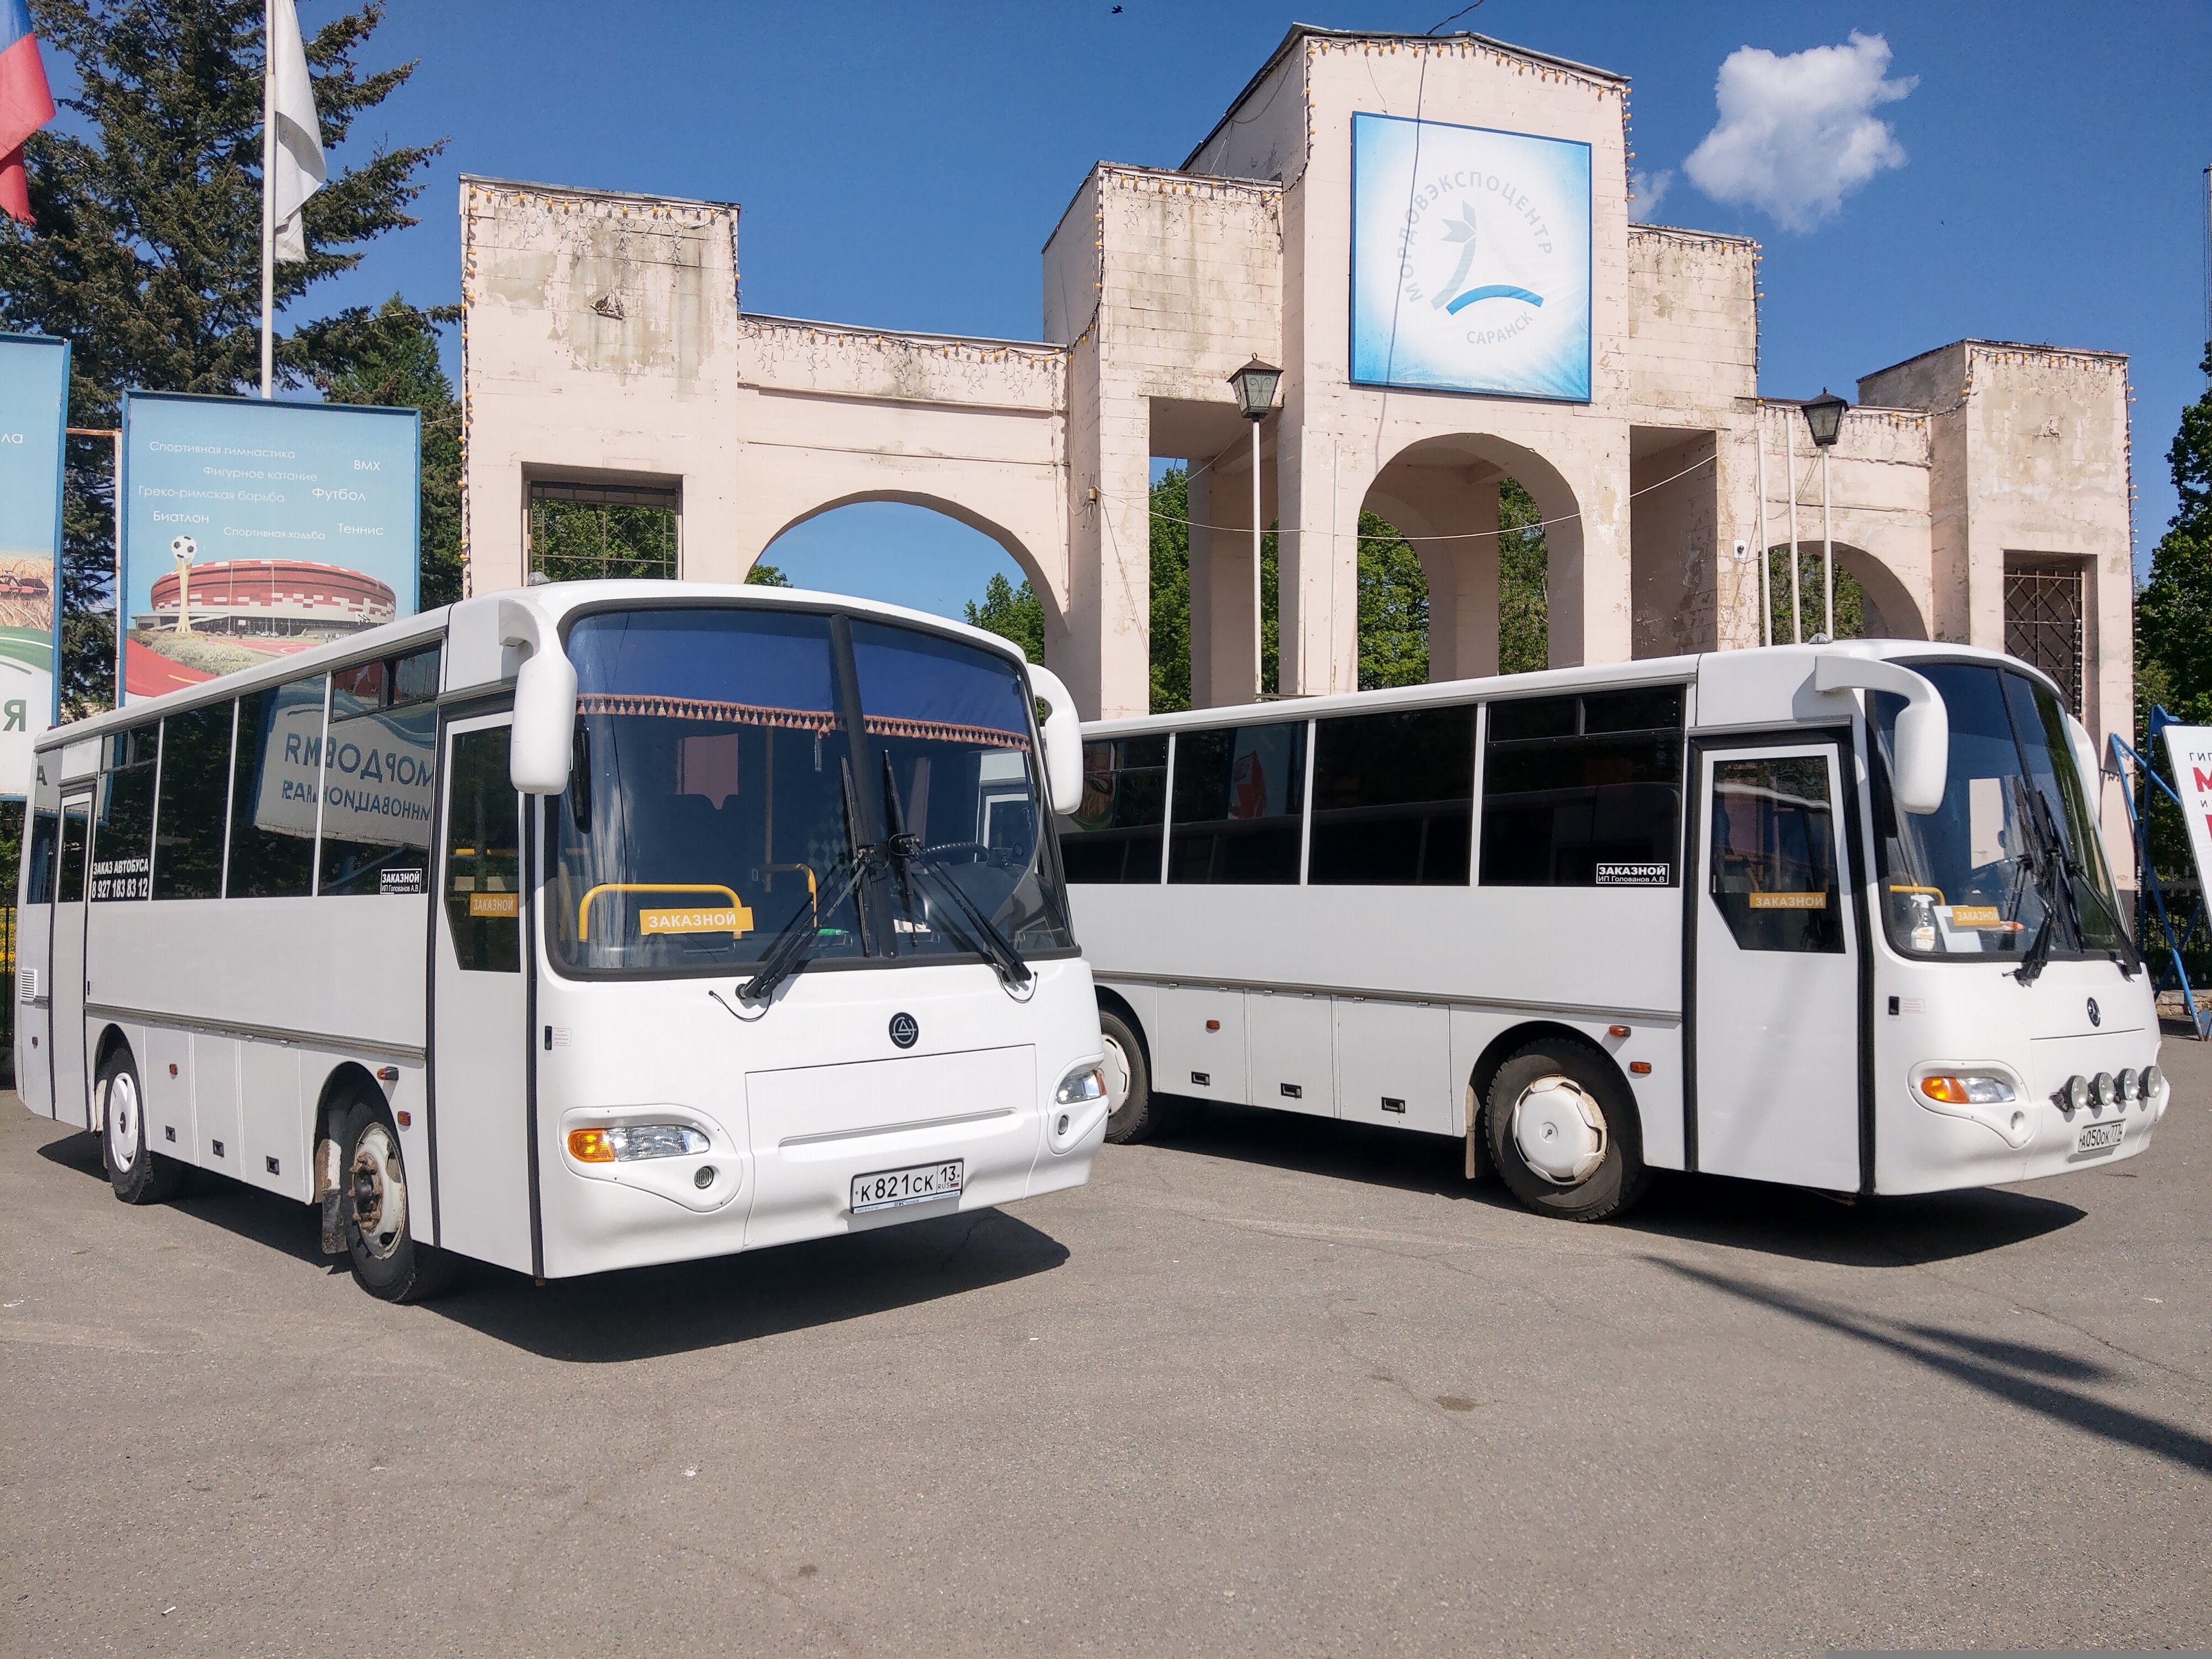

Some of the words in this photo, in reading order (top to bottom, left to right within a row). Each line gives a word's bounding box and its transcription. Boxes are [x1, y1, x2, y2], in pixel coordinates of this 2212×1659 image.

[1397, 171, 1553, 302] МОРДОВЭКСПОЦЕНТР
[1467, 311, 1533, 345] САРАНСК
[149, 441, 221, 454] Спортивная
[225, 447, 295, 459] гимнастика
[203, 467, 264, 479] Фигурное
[268, 472, 317, 482] катание
[139, 486, 234, 499] Греко-римская
[238, 491, 285, 503] борьба
[312, 487, 366, 501] Футбол
[153, 510, 210, 523] Биатлон
[223, 527, 286, 538] Спортивная
[288, 531, 326, 540] ходьба
[338, 523, 384, 535] Теннис
[93, 861, 113, 875] ЗАКАЗ
[114, 858, 149, 873] АВТОБУСА
[1599, 865, 1666, 875] ЗАКАЗНОЙ
[382, 871, 420, 883] ЗАКАЗНОЙ
[92, 880, 97, 899] 8
[97, 880, 111, 898] 927
[112, 879, 126, 898] 183
[127, 878, 137, 897] 83
[138, 878, 148, 896] 12
[474, 897, 513, 911] ЗАКАЗНОЙ
[1755, 895, 1823, 906] ЗАКАЗНОЙ
[649, 911, 736, 928] ЗАКАЗНОЙ
[1957, 909, 2000, 921] ЗАКАЗНОЙ
[940, 1166, 956, 1182] 13
